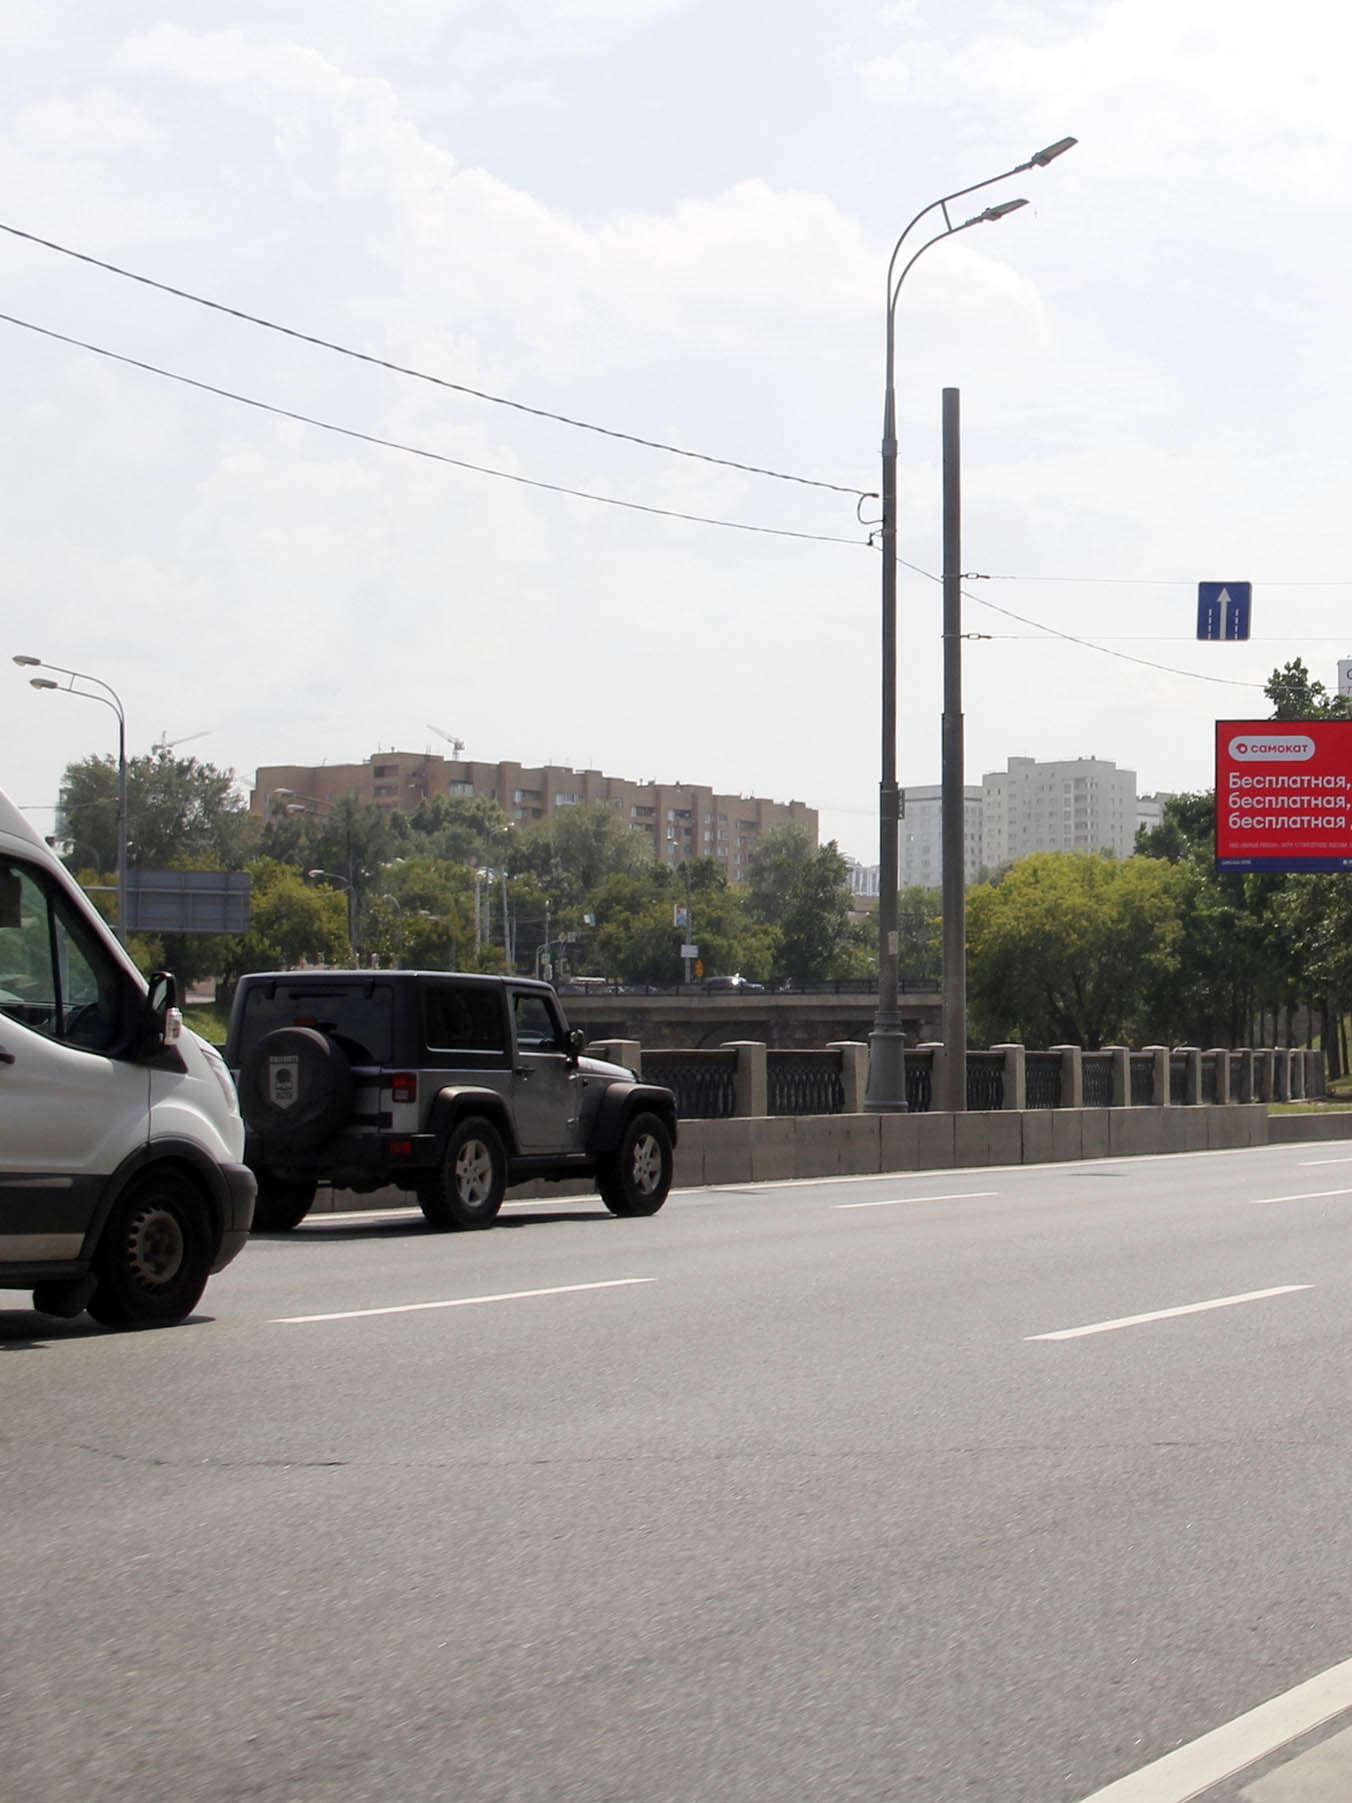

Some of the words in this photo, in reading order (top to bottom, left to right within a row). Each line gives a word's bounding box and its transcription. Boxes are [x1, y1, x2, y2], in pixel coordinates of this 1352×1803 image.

[1250, 744, 1309, 753] самокат
[1228, 771, 1352, 790] Бесплатная,
[1228, 791, 1351, 811] бесплатная,
[1228, 811, 1346, 829] бесплатная
